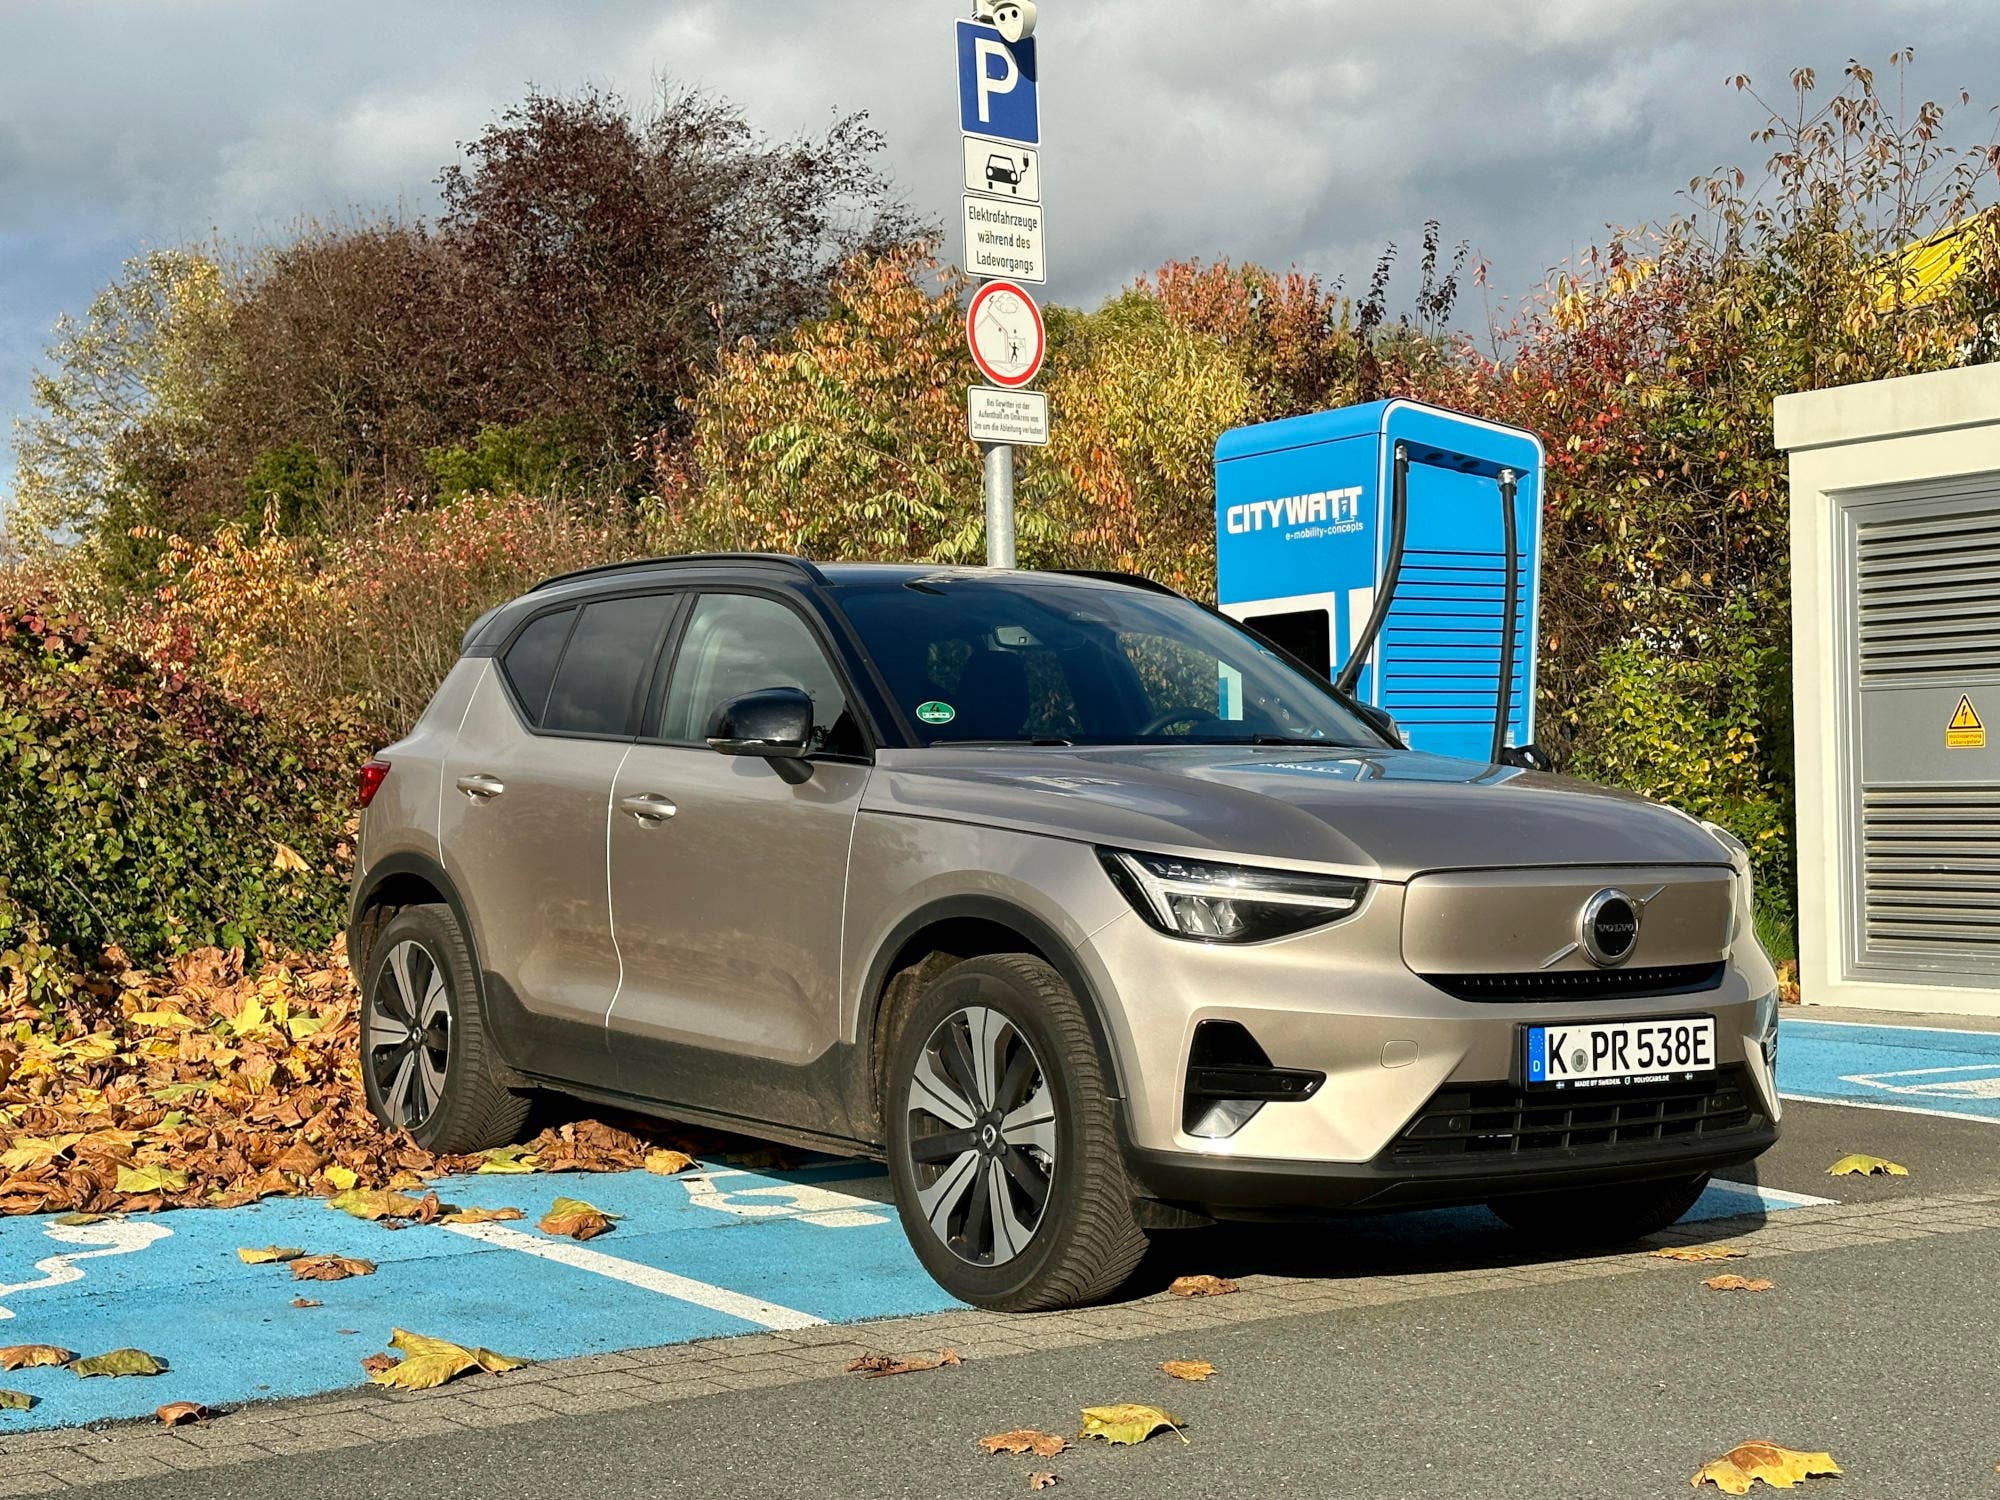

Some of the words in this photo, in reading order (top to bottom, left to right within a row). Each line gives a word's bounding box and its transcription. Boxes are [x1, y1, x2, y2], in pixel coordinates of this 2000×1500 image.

[974, 37, 1019, 123] P
[969, 206, 1038, 231] Elektrofahrzeuge
[978, 230, 1013, 247] während
[1016, 234, 1031, 249] des
[976, 251, 1034, 274] Ladevorgangs
[1227, 486, 1363, 534] CITYWATT
[1285, 521, 1364, 541] e-mobility-concepts
[1597, 923, 1634, 932] VOLVO
[1548, 1033, 1567, 1074] K
[1532, 1060, 1540, 1072] D
